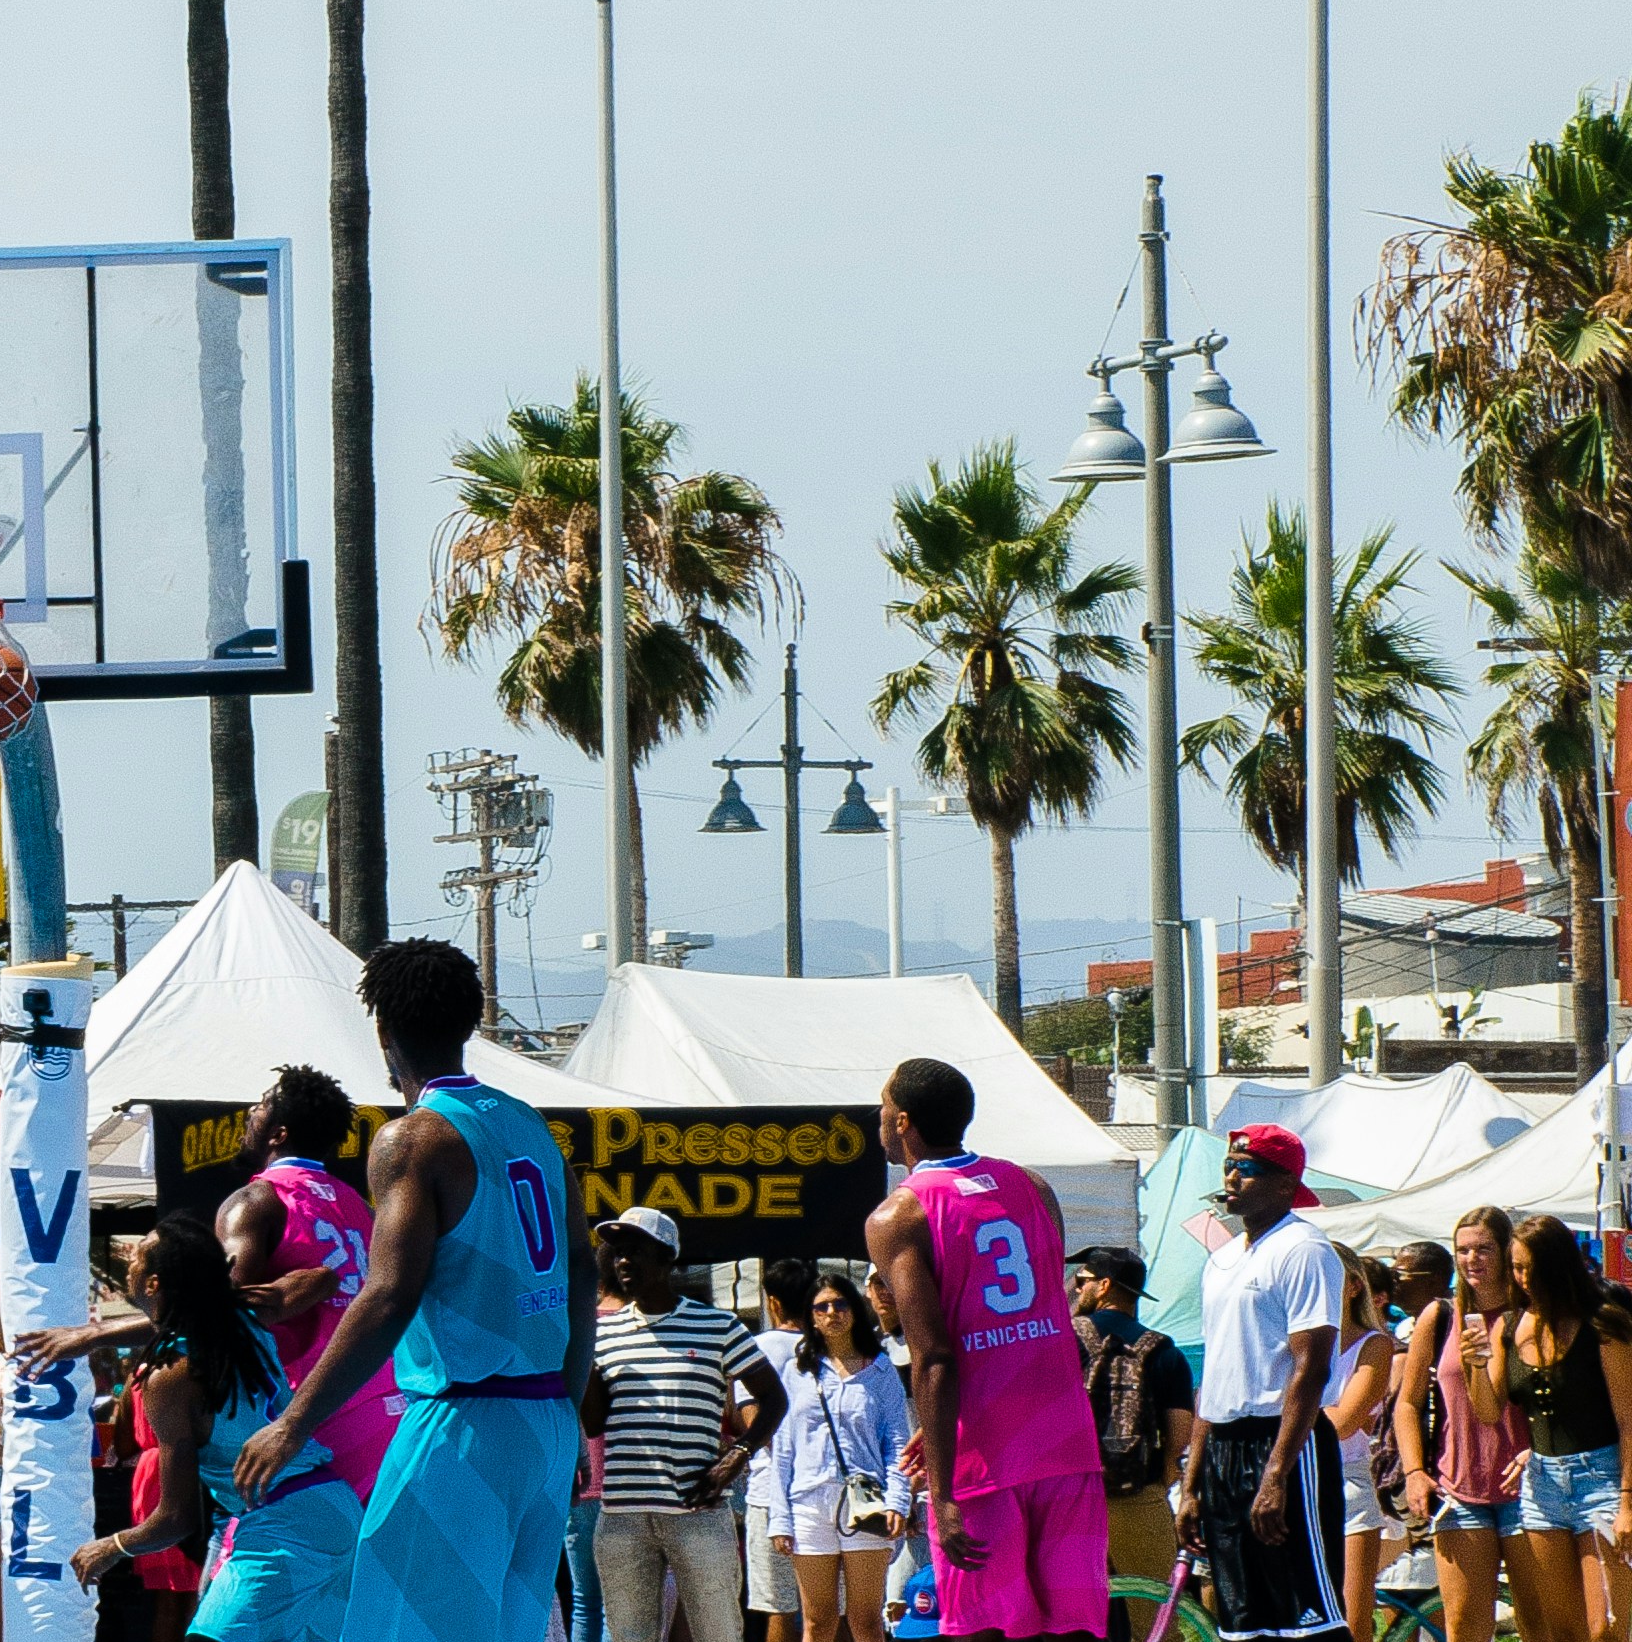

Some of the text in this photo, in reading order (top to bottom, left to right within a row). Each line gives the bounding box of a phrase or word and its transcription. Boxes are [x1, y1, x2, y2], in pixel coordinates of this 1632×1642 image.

[183, 1110, 248, 1165] ORGA
[506, 1156, 558, 1276] 0
[576, 1173, 804, 1217] NADE
[975, 1218, 1037, 1316] 3
